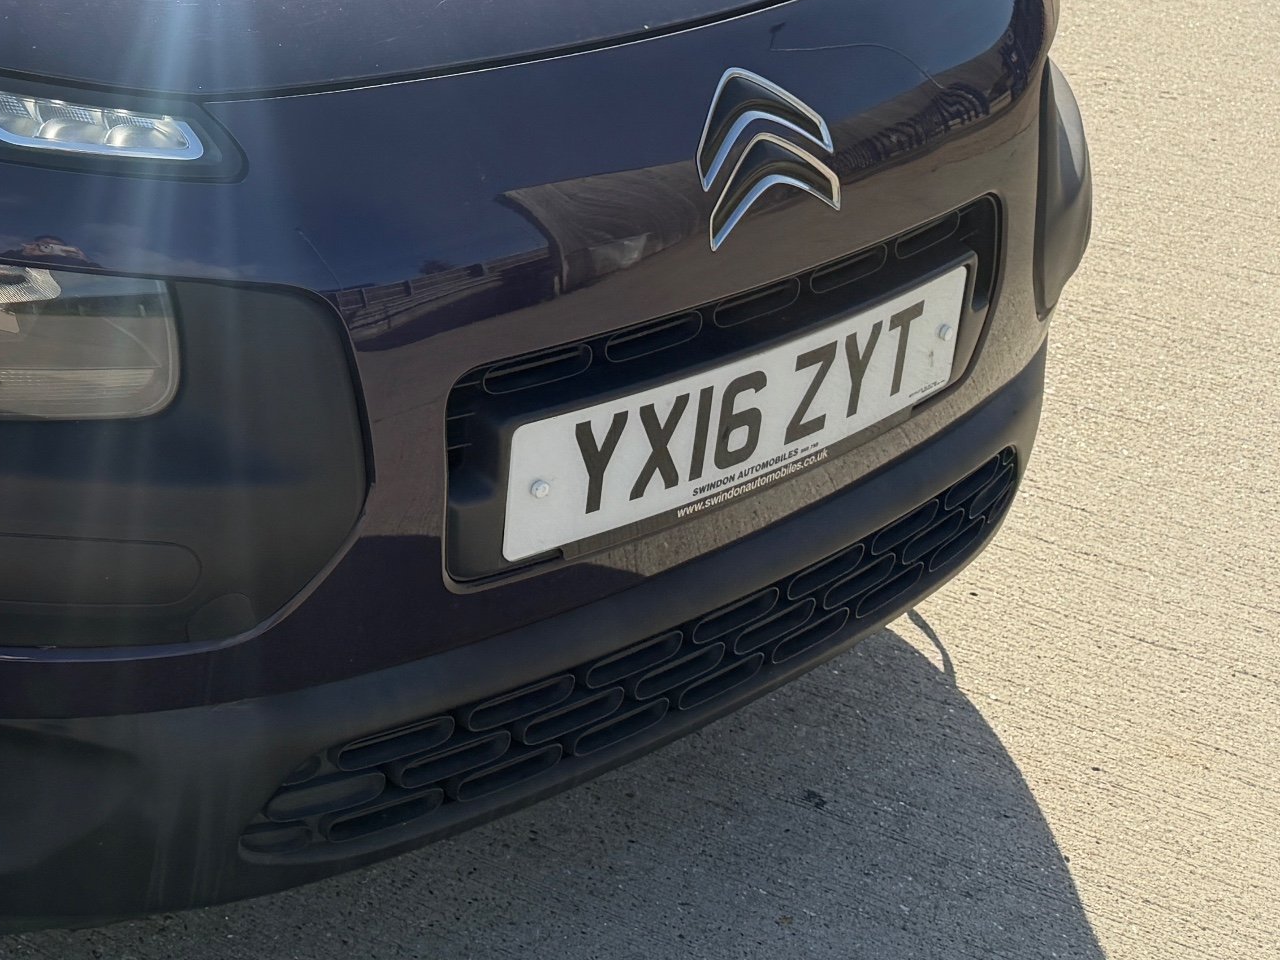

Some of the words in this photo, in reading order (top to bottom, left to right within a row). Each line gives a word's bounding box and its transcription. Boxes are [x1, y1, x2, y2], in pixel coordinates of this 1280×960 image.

[575, 370, 768, 515] YX16
[783, 300, 925, 446] ZYT
[677, 448, 828, 518] www.swindonautomobiles.co.uk
[692, 473, 735, 497] SWINDON
[737, 448, 798, 480] AUTOMOBILES
